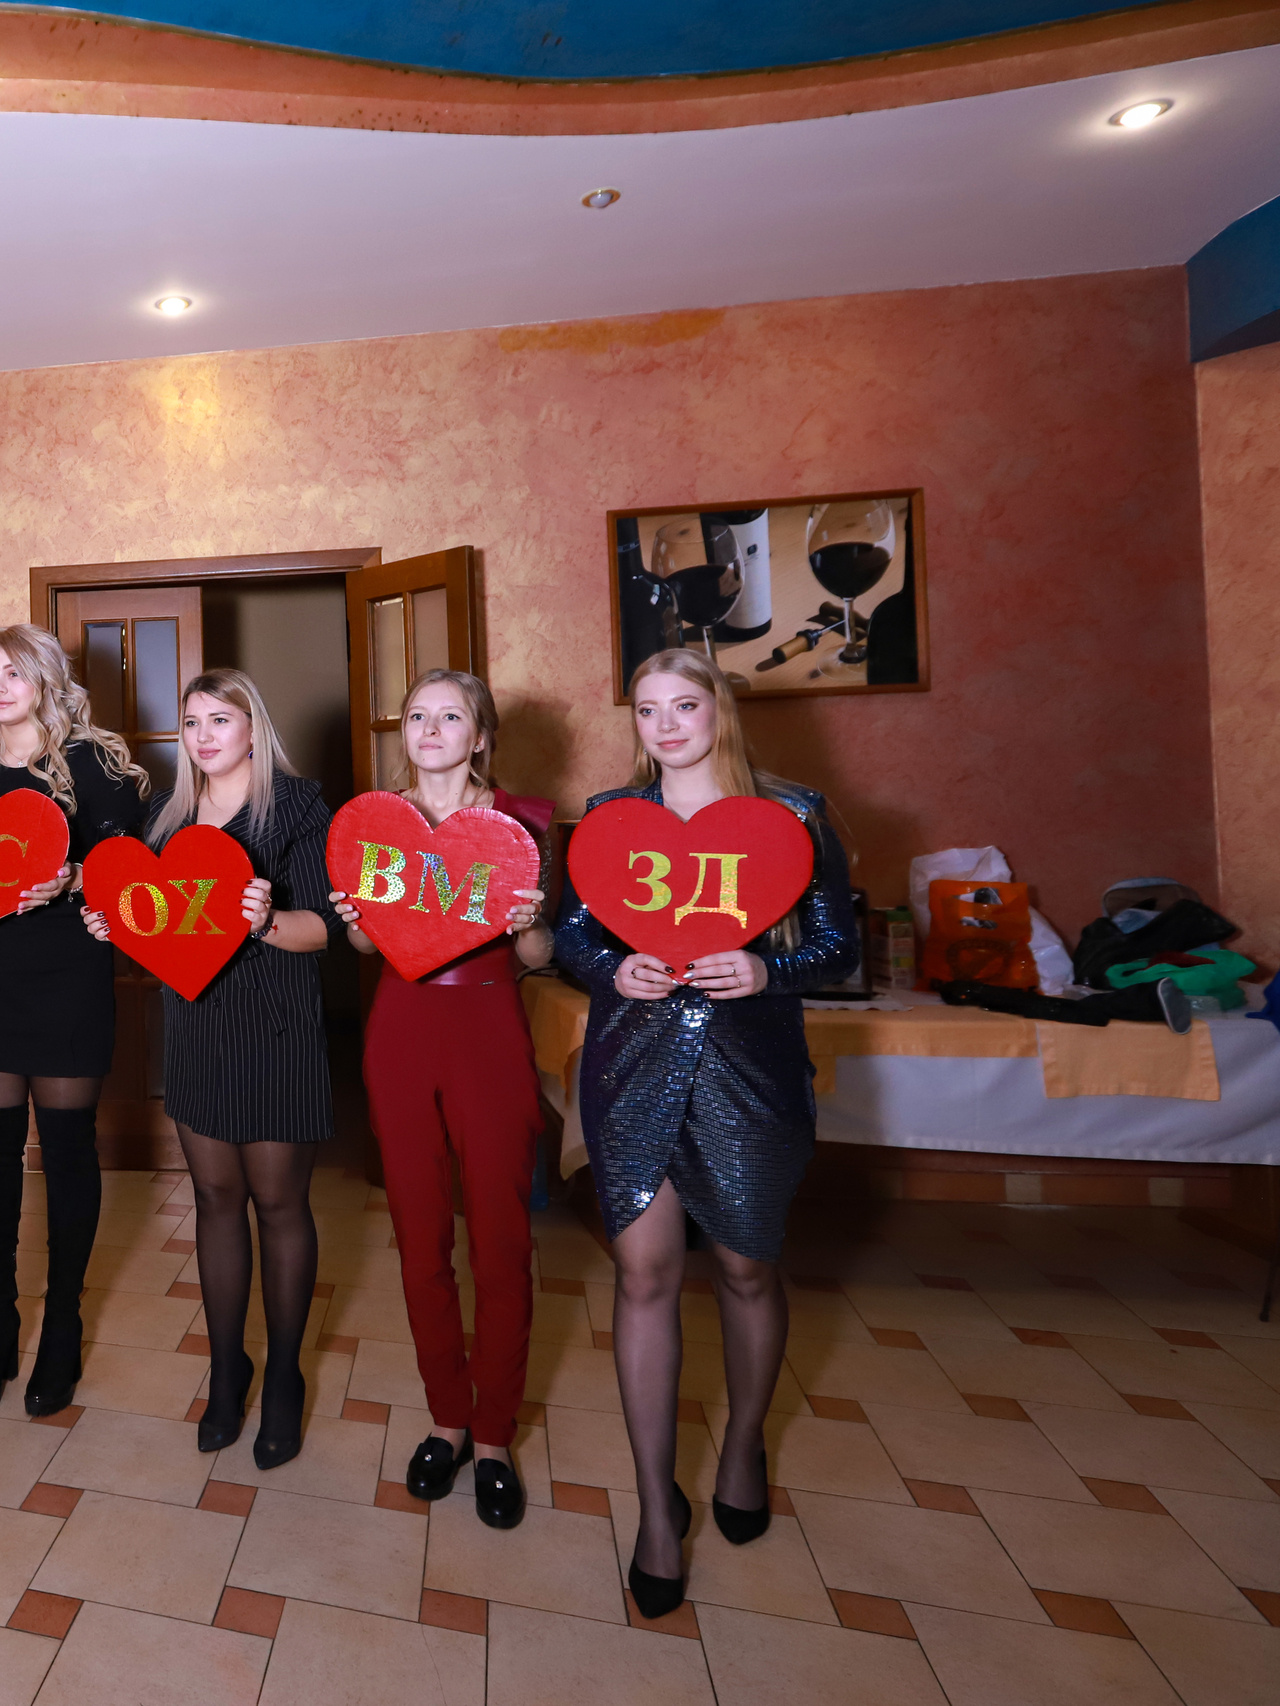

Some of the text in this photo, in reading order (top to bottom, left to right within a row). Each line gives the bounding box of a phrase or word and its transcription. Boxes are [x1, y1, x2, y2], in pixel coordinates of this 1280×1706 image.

[118, 879, 226, 937] ОХ
[349, 840, 499, 926] ВМ
[623, 850, 748, 930] ЗД
